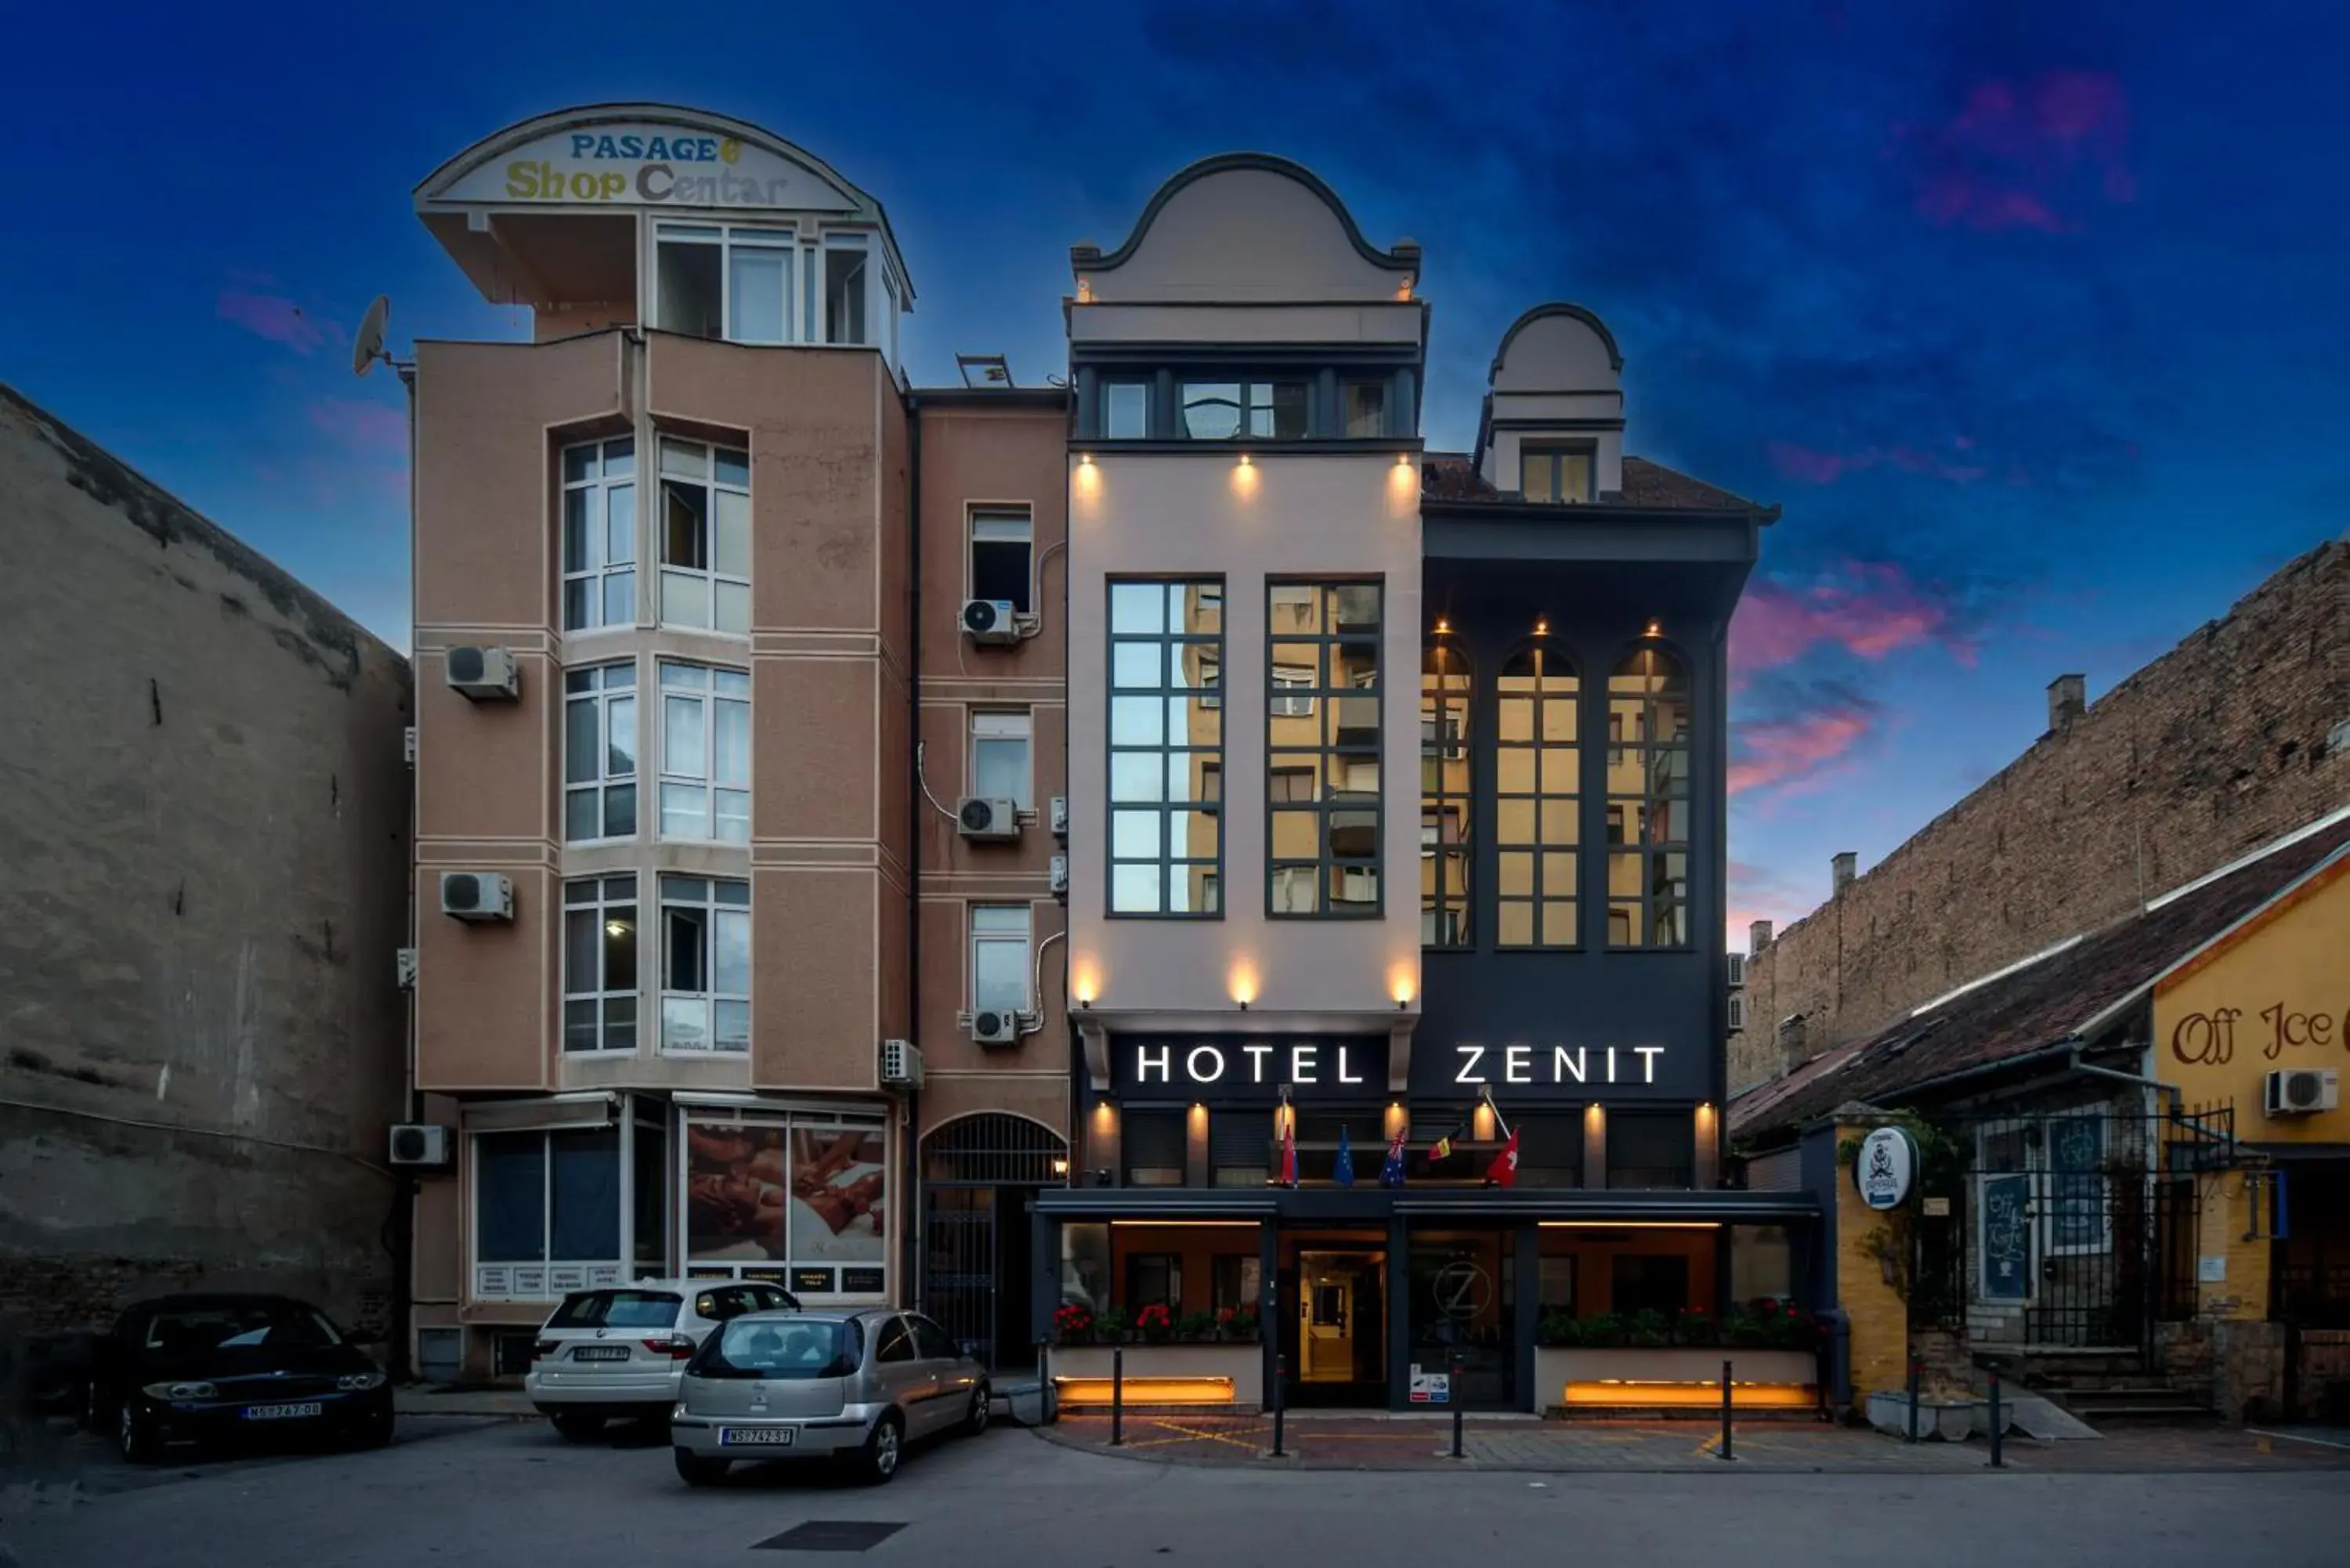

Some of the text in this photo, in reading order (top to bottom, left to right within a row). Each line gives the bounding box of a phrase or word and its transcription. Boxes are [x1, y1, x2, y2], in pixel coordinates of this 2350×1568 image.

[571, 135, 718, 162] PASAGE
[505, 160, 788, 205] Shop Centar
[2171, 1007, 2243, 1065] Off
[1138, 1045, 1665, 1083] HOTEL ZENIT
